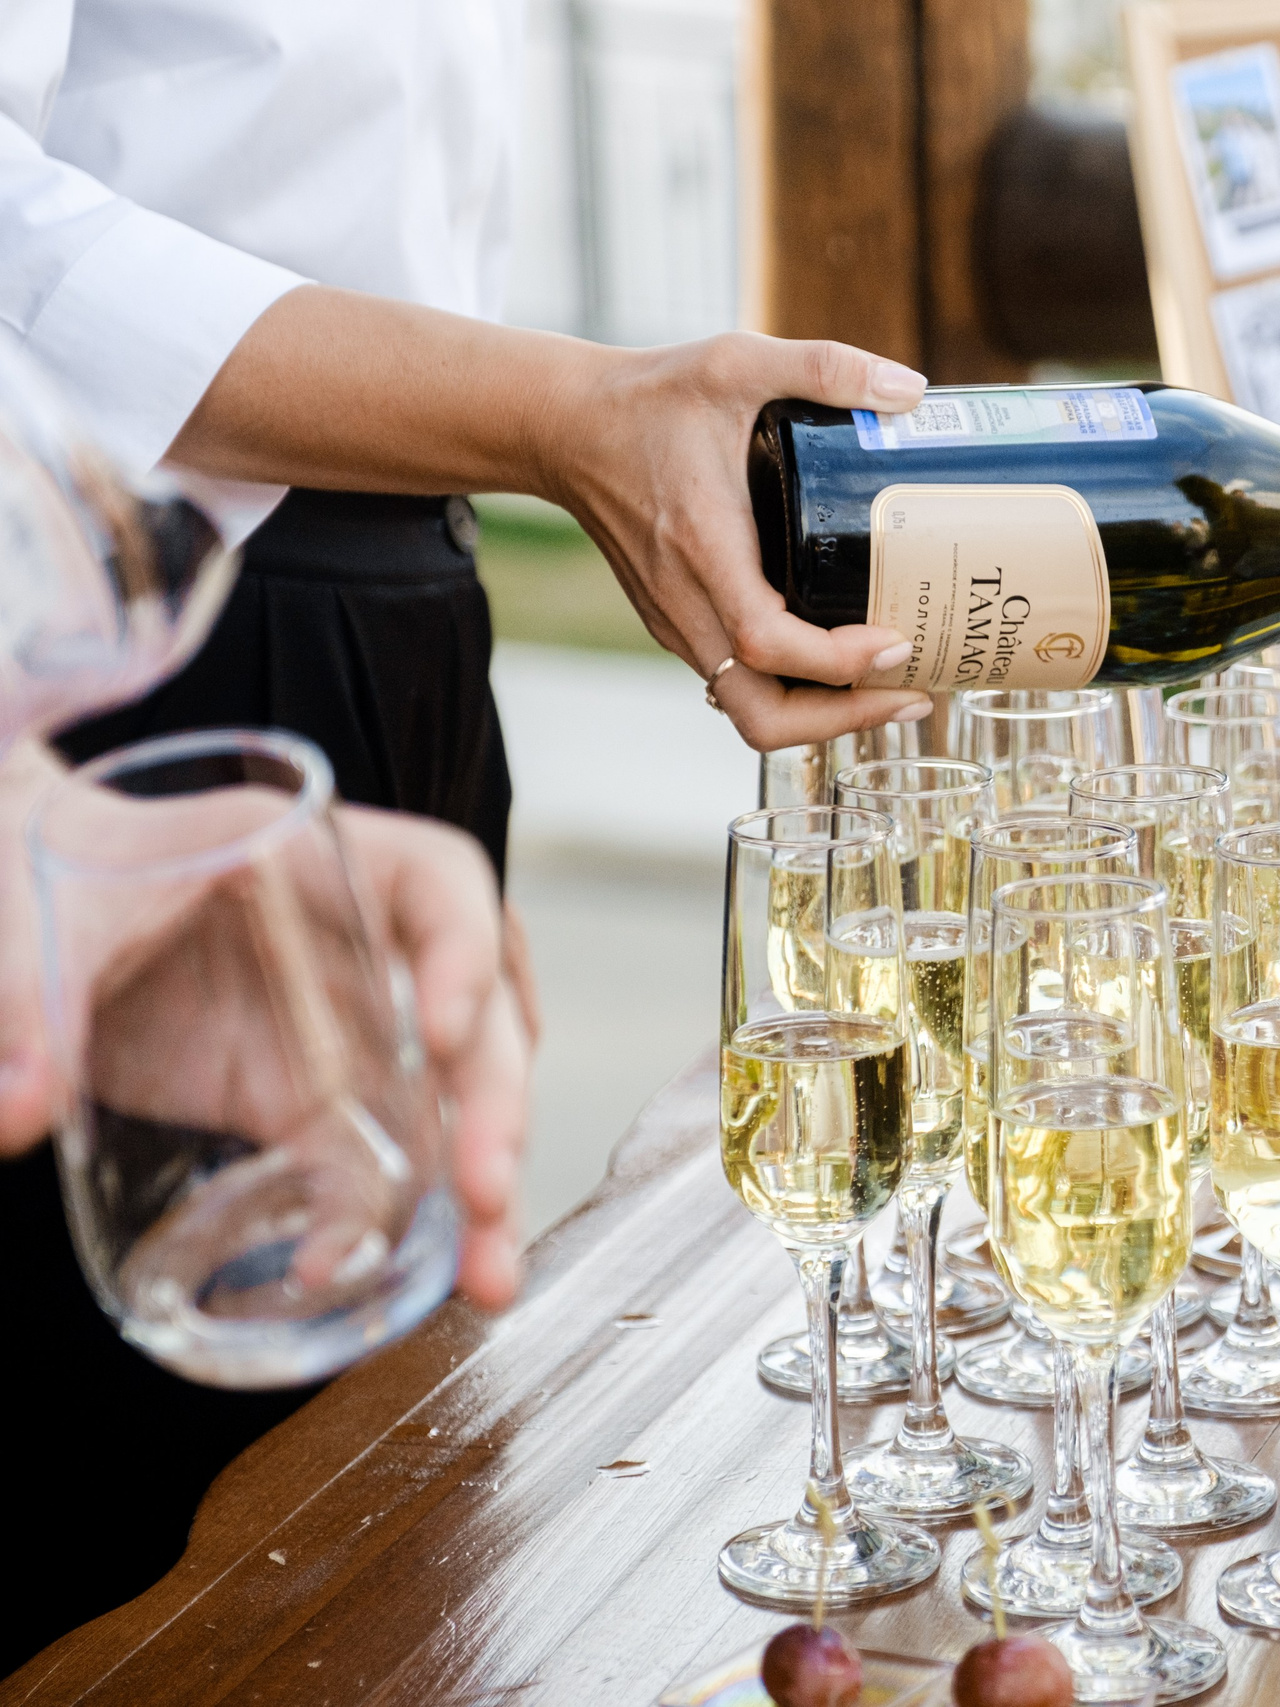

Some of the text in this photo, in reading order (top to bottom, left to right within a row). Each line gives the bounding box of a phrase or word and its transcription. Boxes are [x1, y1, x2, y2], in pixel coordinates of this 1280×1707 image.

[892, 511, 906, 524] 0,75
[951, 566, 1003, 690] TAMAGN
[985, 594, 1032, 685] Château
